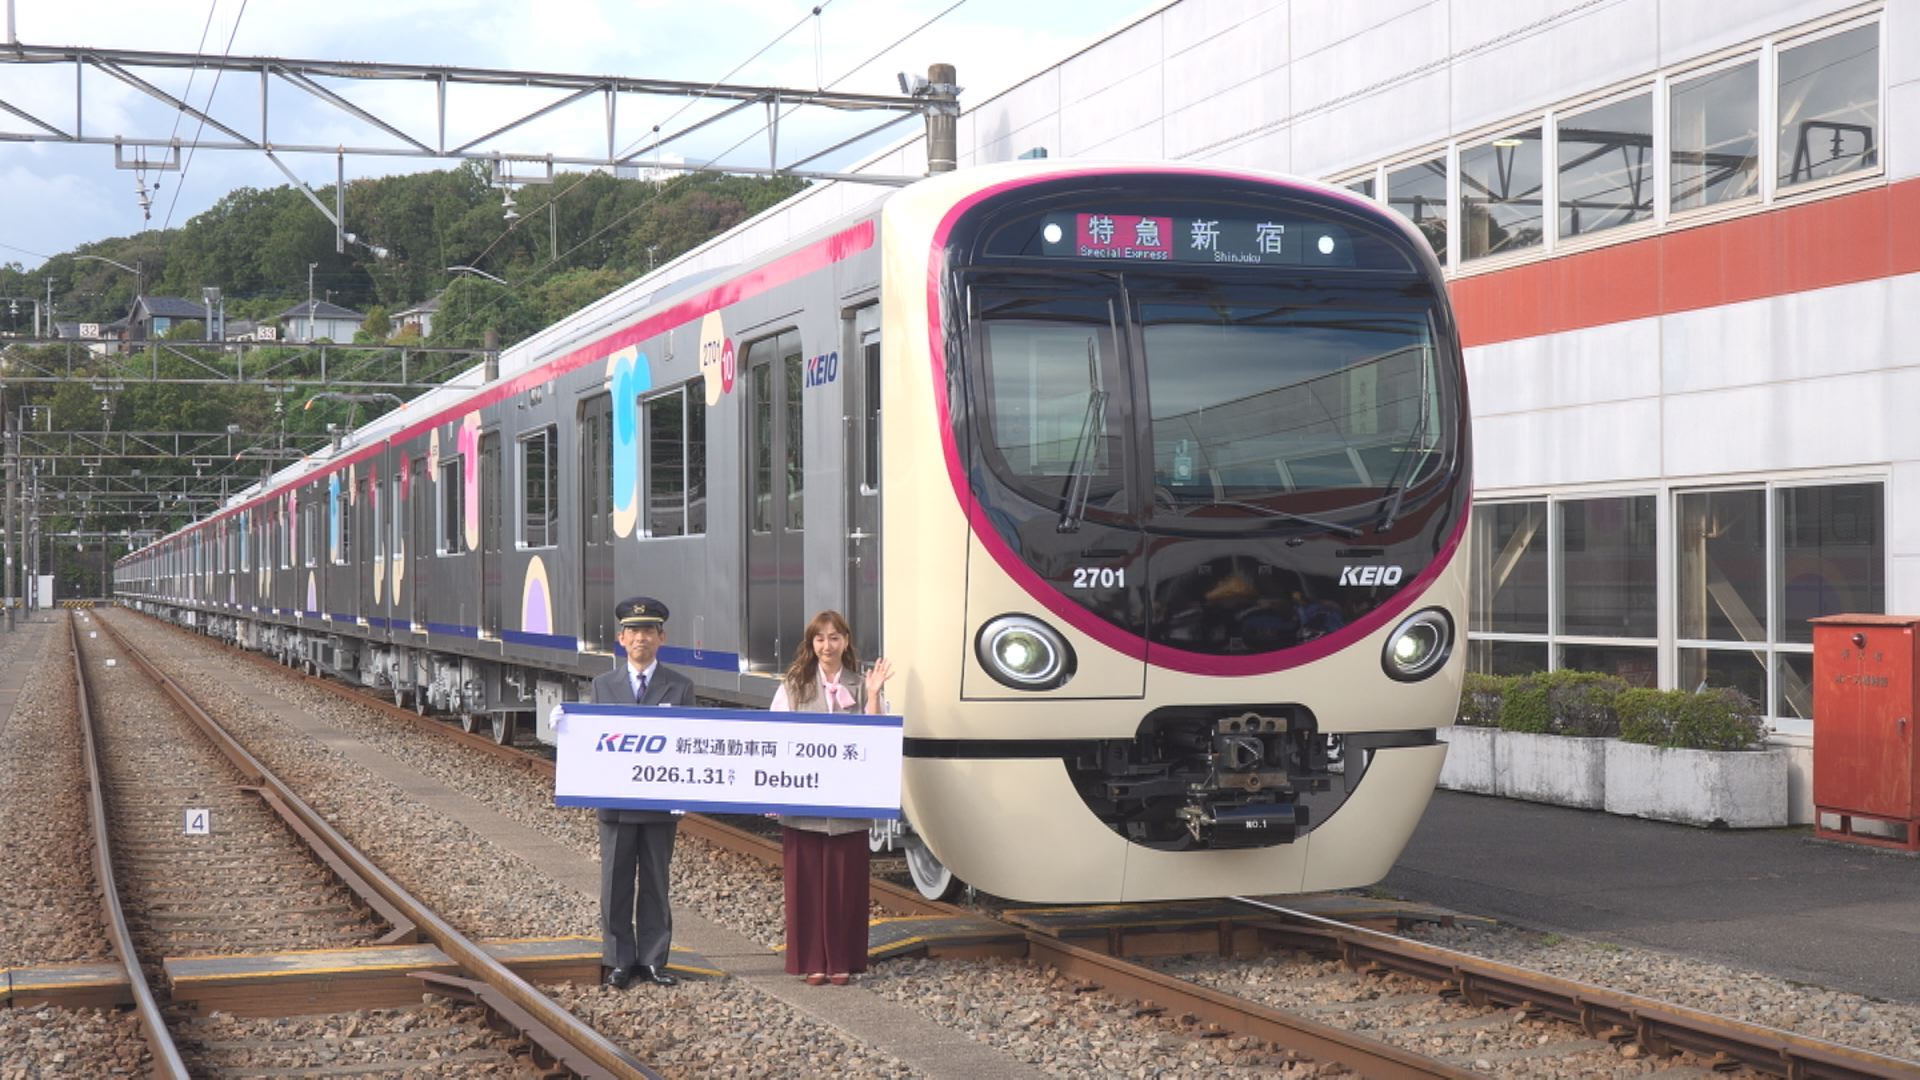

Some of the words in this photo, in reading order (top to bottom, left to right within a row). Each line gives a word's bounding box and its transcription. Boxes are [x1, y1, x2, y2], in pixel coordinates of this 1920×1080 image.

[1089, 215, 1161, 247] 特急
[1190, 219, 1285, 254] 新宿
[1081, 245, 1121, 258] Special
[1124, 247, 1168, 260] Express
[1214, 251, 1261, 264] Shinjuku
[81, 325, 97, 337] 32
[703, 340, 721, 366] 2701
[722, 350, 733, 380] 10
[806, 351, 838, 388] KEIO
[1073, 567, 1125, 588] 2701
[1339, 565, 1403, 586] KEIO
[596, 733, 668, 754] KEIO
[632, 765, 726, 785] 2026.1.31
[754, 769, 820, 789] Debut!
[191, 813, 204, 831] 4
